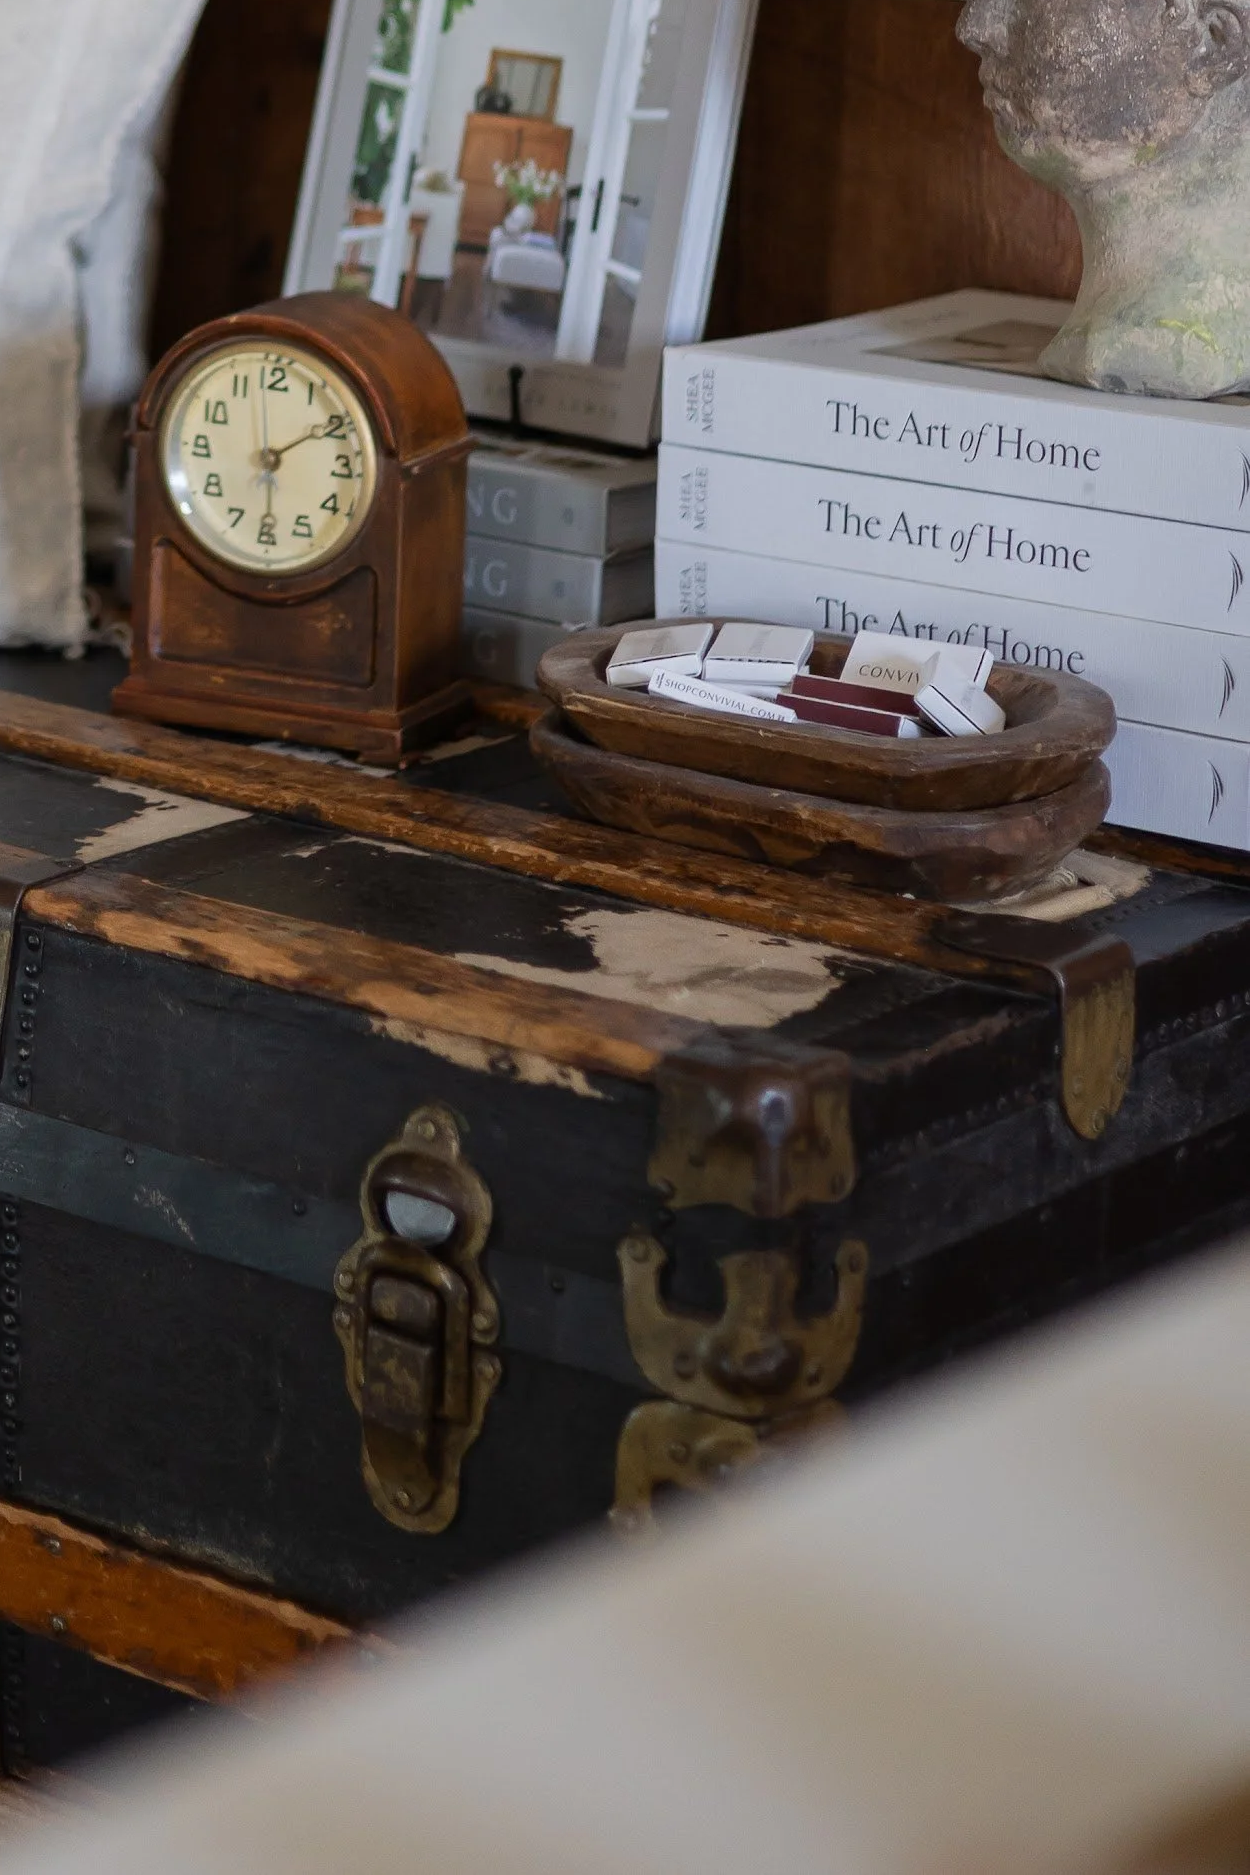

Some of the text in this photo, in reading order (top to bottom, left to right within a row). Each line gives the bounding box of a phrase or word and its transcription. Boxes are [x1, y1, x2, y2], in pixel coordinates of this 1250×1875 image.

[232, 373, 248, 398] 11
[260, 366, 289, 393] 12
[307, 381, 314, 406] 1
[686, 372, 700, 422] SHEA
[205, 398, 228, 425] 10
[324, 414, 347, 441] 2
[825, 399, 1102, 472] The Art of Home
[191, 434, 211, 459] 9
[331, 454, 353, 479] 3
[203, 473, 223, 497] 8
[679, 471, 692, 521] SHEA
[227, 507, 245, 528] 7
[319, 492, 340, 516] 4
[291, 514, 313, 538] 5
[817, 498, 1091, 573] The Art of Home
[679, 565, 693, 615] SHEA
[815, 595, 1086, 675] The Art of Home
